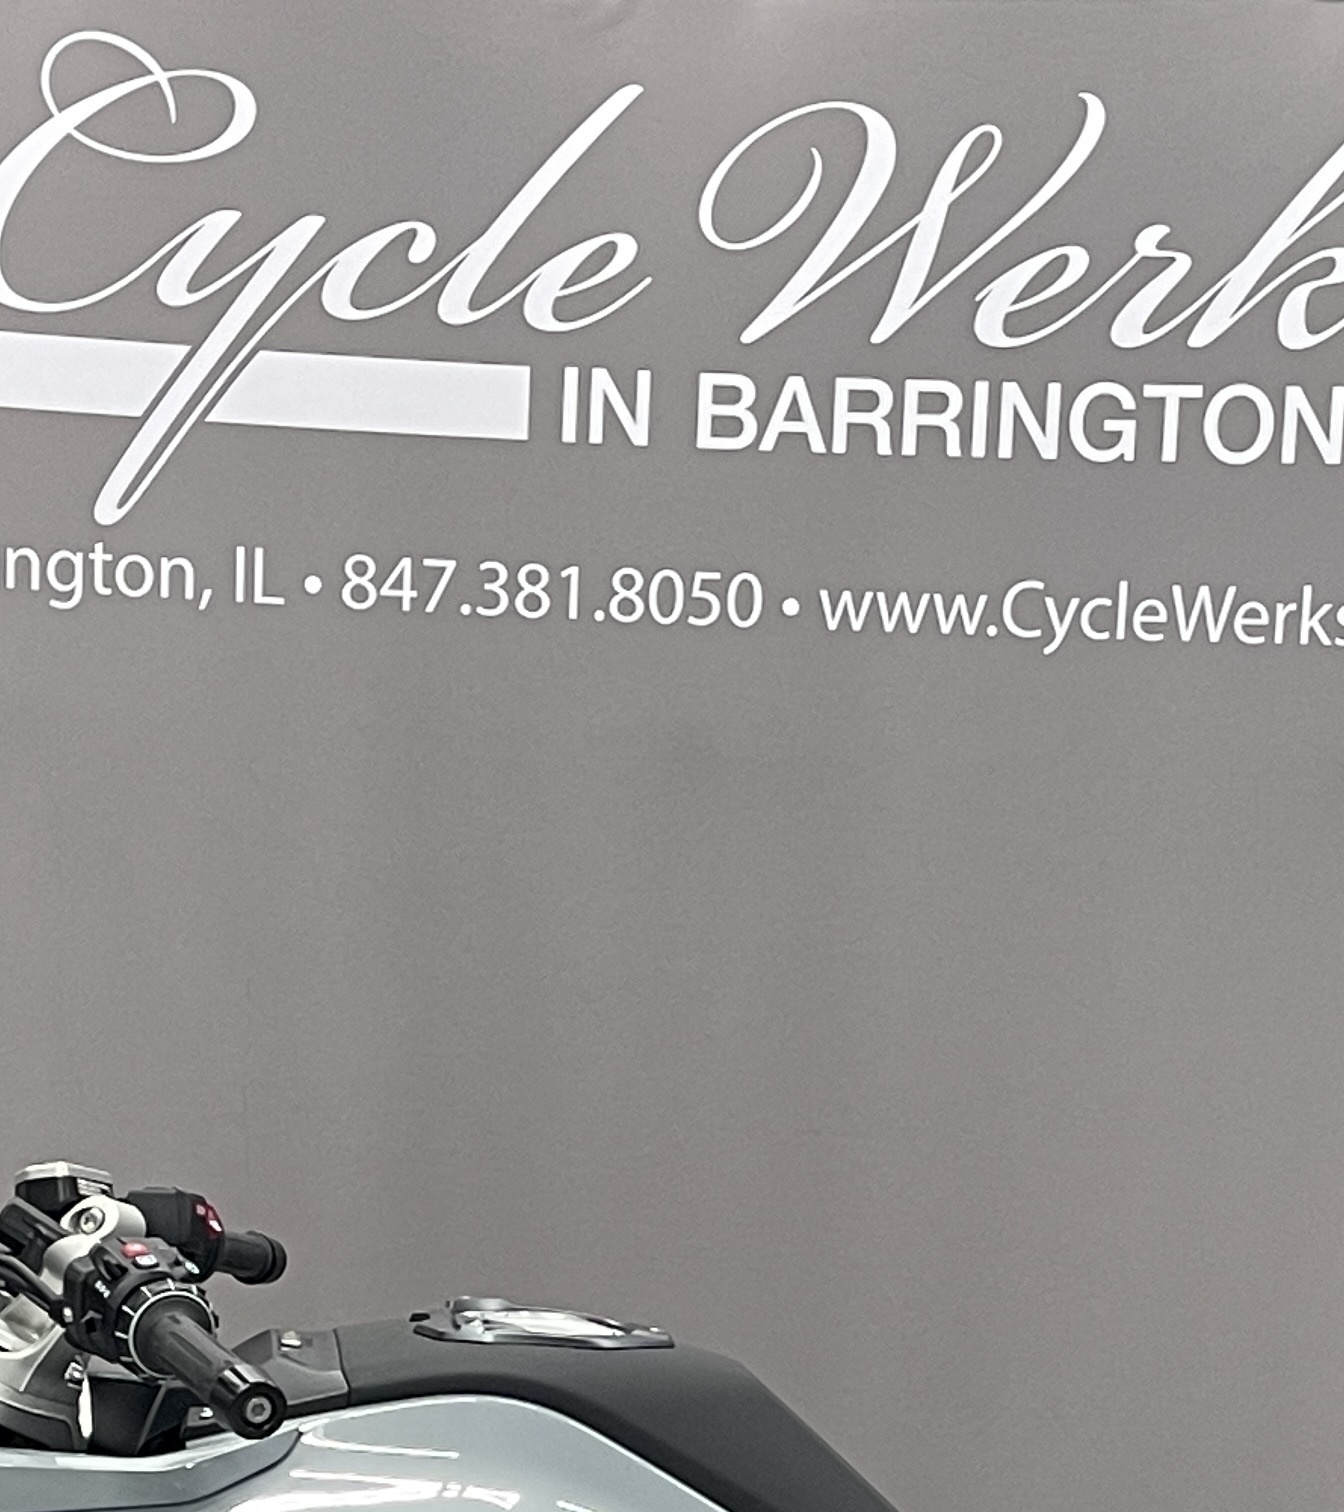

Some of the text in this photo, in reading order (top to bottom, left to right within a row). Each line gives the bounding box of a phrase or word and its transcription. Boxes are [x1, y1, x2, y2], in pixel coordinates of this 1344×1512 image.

[560, 365, 653, 448] IN
[234, 545, 286, 606] IL
[340, 553, 764, 629] 847.381.8050
